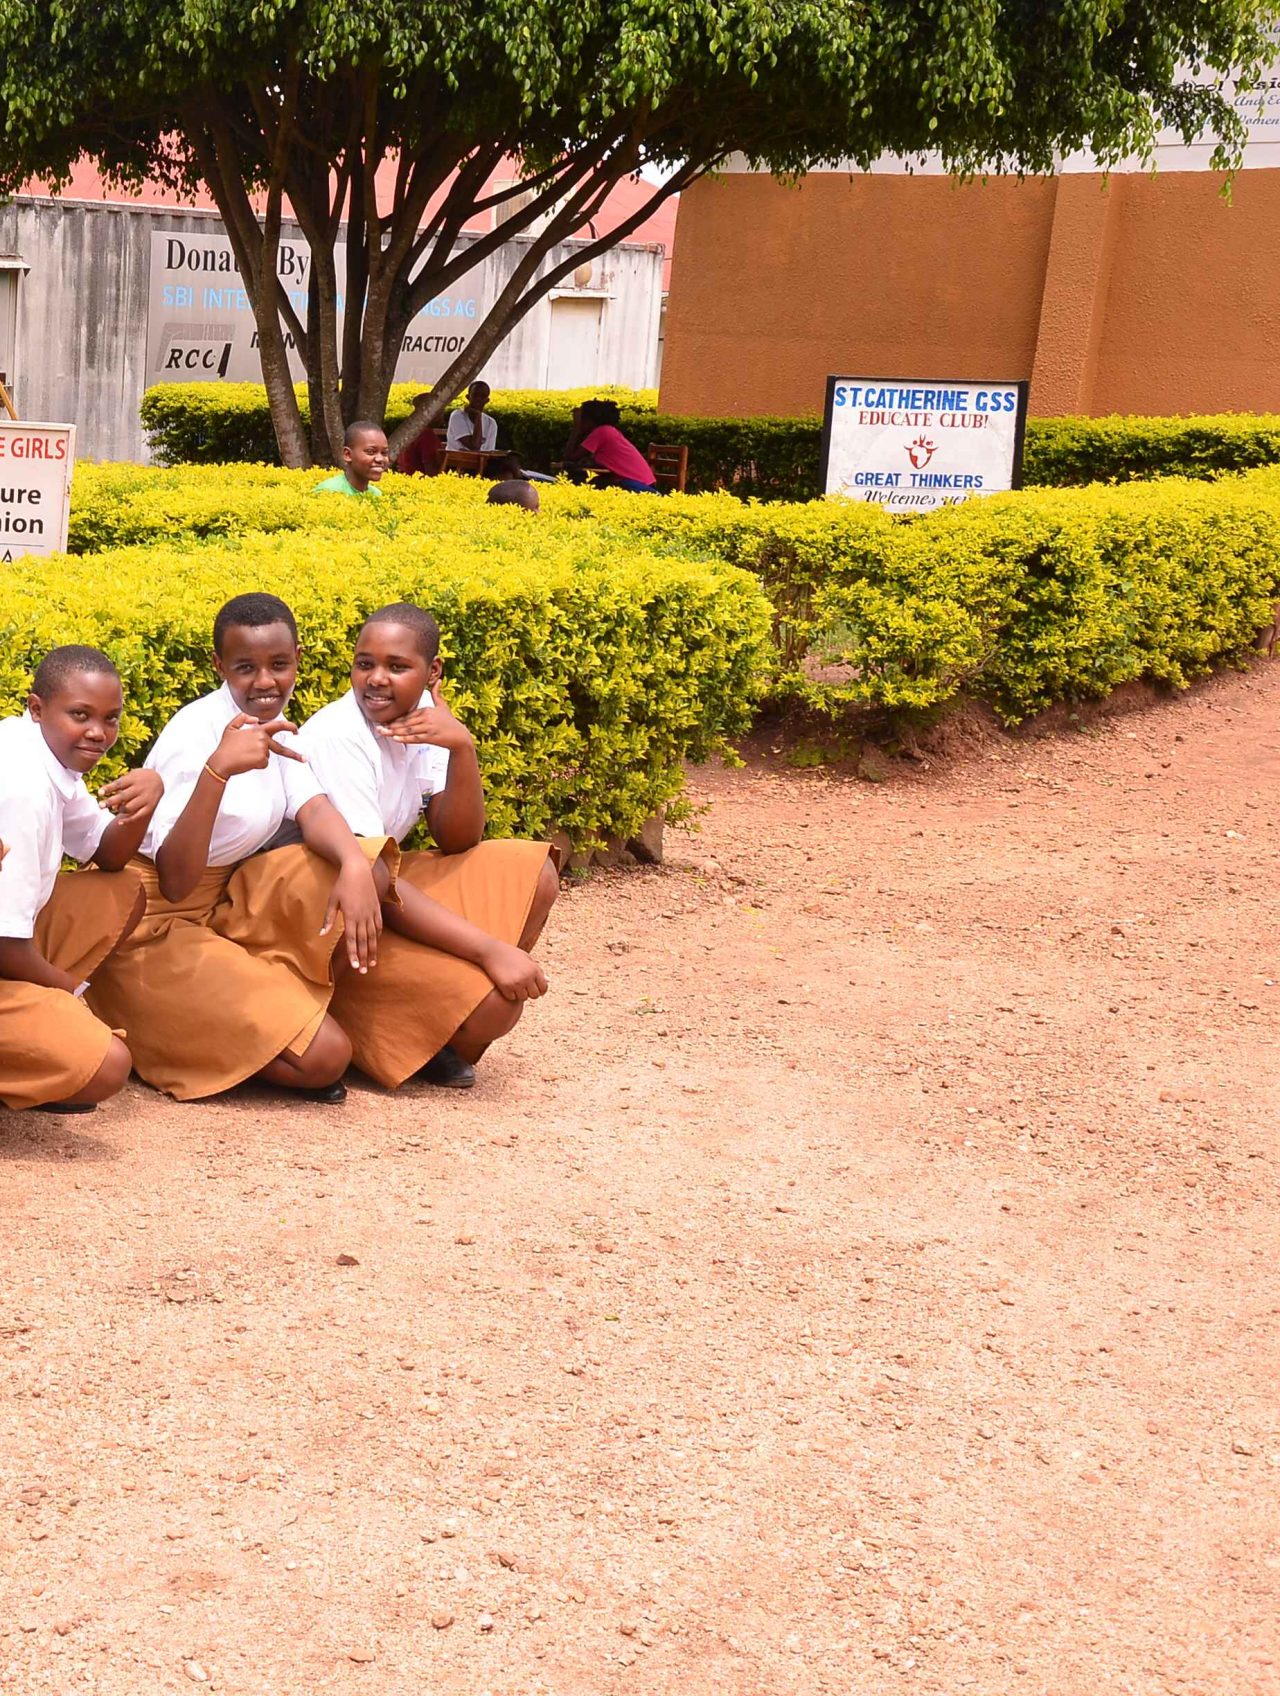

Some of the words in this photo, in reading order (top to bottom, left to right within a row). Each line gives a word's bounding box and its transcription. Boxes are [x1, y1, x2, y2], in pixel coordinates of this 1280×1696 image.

[1240, 115, 1279, 125] omen
[278, 245, 310, 285] By
[162, 285, 193, 308] SBI
[454, 300, 477, 318] AG
[975, 391, 1016, 412] GSS
[858, 410, 933, 427] EDUCATE
[939, 413, 989, 429] CLUB!
[11, 437, 66, 460] GIRLS
[854, 472, 902, 487] GREAT
[910, 473, 984, 488] THINKERS
